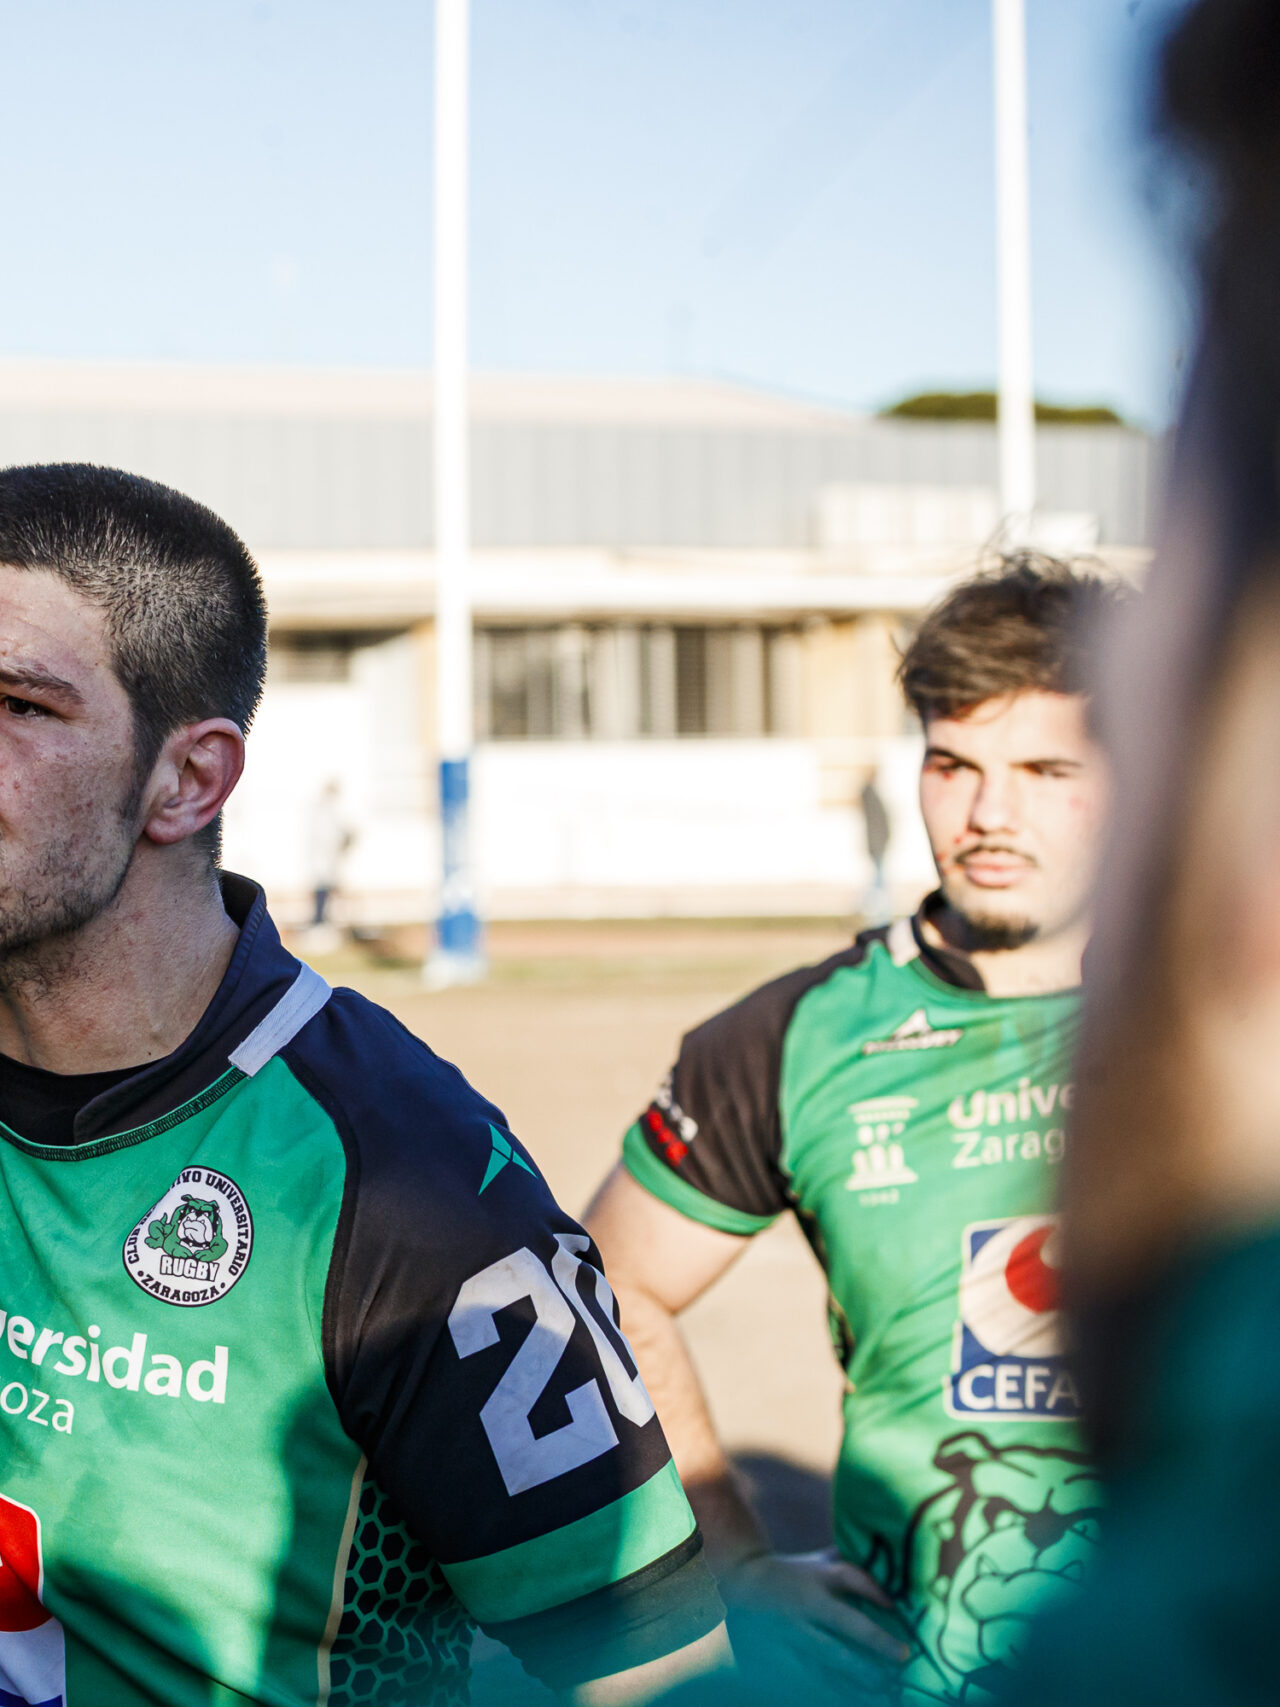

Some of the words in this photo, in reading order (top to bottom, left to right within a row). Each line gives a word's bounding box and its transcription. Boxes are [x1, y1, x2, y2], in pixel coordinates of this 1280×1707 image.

[205, 1172, 249, 1277] UNIVERSITARIO
[140, 1273, 220, 1303] ZARAGOZA
[160, 1254, 221, 1282] RUGBY
[447, 1233, 656, 1496] 20
[958, 1363, 1081, 1411] CEFA
